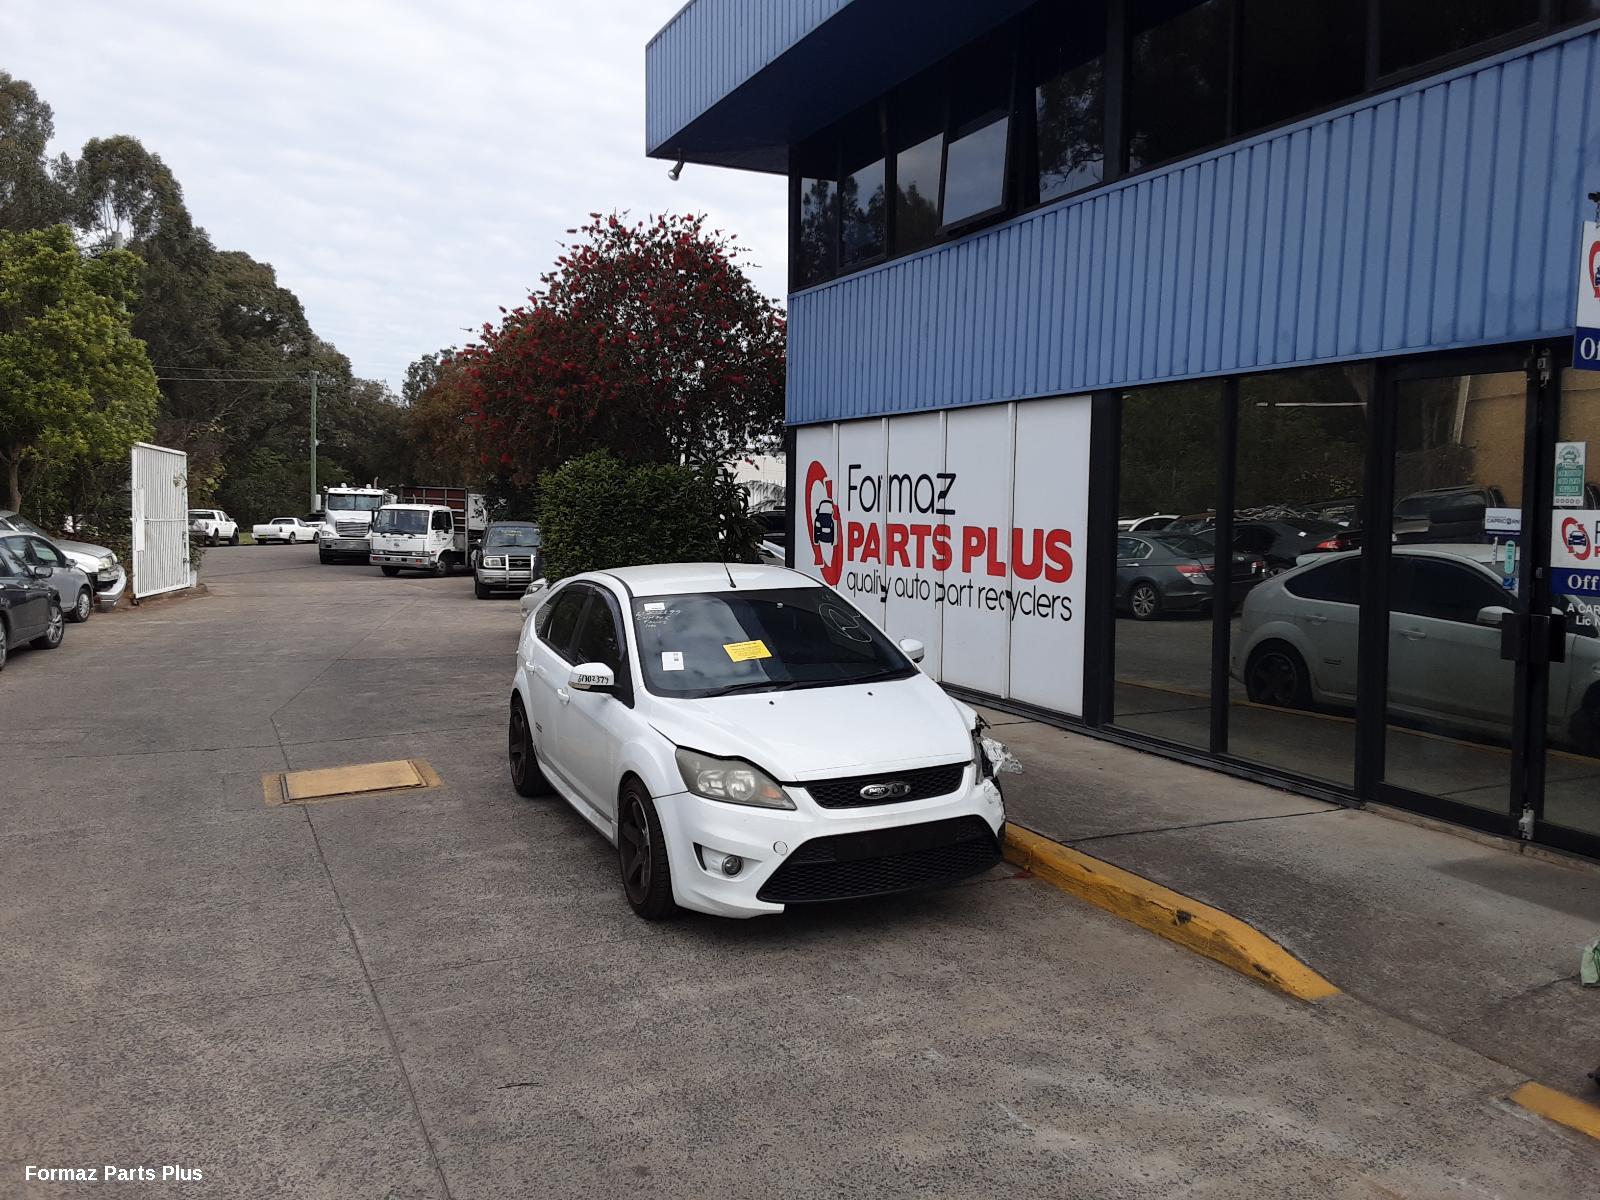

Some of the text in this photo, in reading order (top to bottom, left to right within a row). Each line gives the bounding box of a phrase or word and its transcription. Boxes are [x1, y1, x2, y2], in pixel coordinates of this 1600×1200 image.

[848, 464, 957, 515] Formaz
[847, 521, 1073, 583] PARTS PLUS
[894, 572, 930, 600] auto
[935, 578, 973, 610] part
[978, 585, 1072, 621] recyclers
[1567, 574, 1600, 591] Off
[1566, 603, 1575, 612] A
[1576, 615, 1591, 626] Lic
